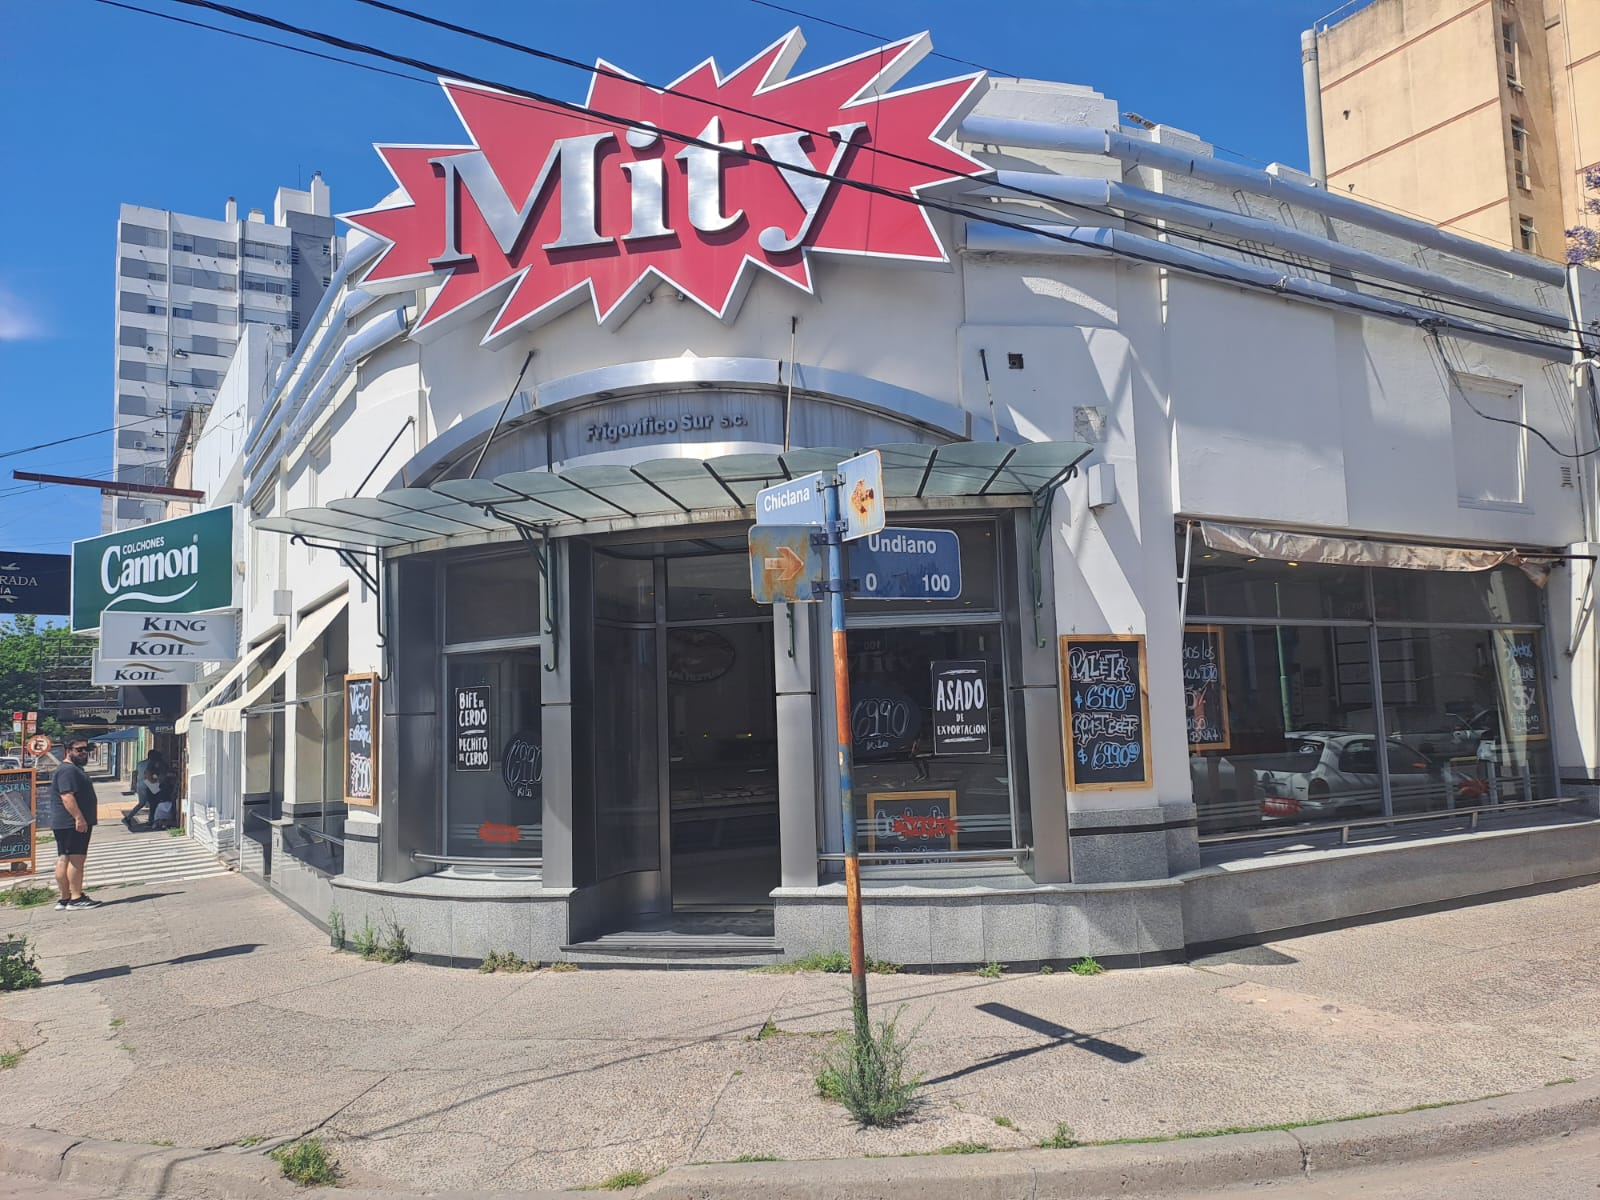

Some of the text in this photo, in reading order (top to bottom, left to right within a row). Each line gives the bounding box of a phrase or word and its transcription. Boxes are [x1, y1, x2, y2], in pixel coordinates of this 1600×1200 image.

[428, 115, 867, 266] Mity
[586, 416, 678, 443] Frigorifico
[680, 413, 713, 432] Sur
[764, 487, 810, 512] Chiclana
[122, 536, 165, 555] COLCHONES
[868, 534, 937, 554] Undiano
[101, 544, 198, 595] Cannon
[866, 573, 951, 592] 0 100
[142, 616, 207, 632] KING
[128, 641, 190, 656] KOIL
[1069, 648, 1128, 682] PALETA
[114, 669, 160, 681] KOIL
[936, 678, 985, 712] ASADO
[459, 708, 487, 727] CERDO
[955, 713, 965, 722] DE
[458, 736, 488, 752] PECHITO
[465, 751, 489, 766] CERDO
